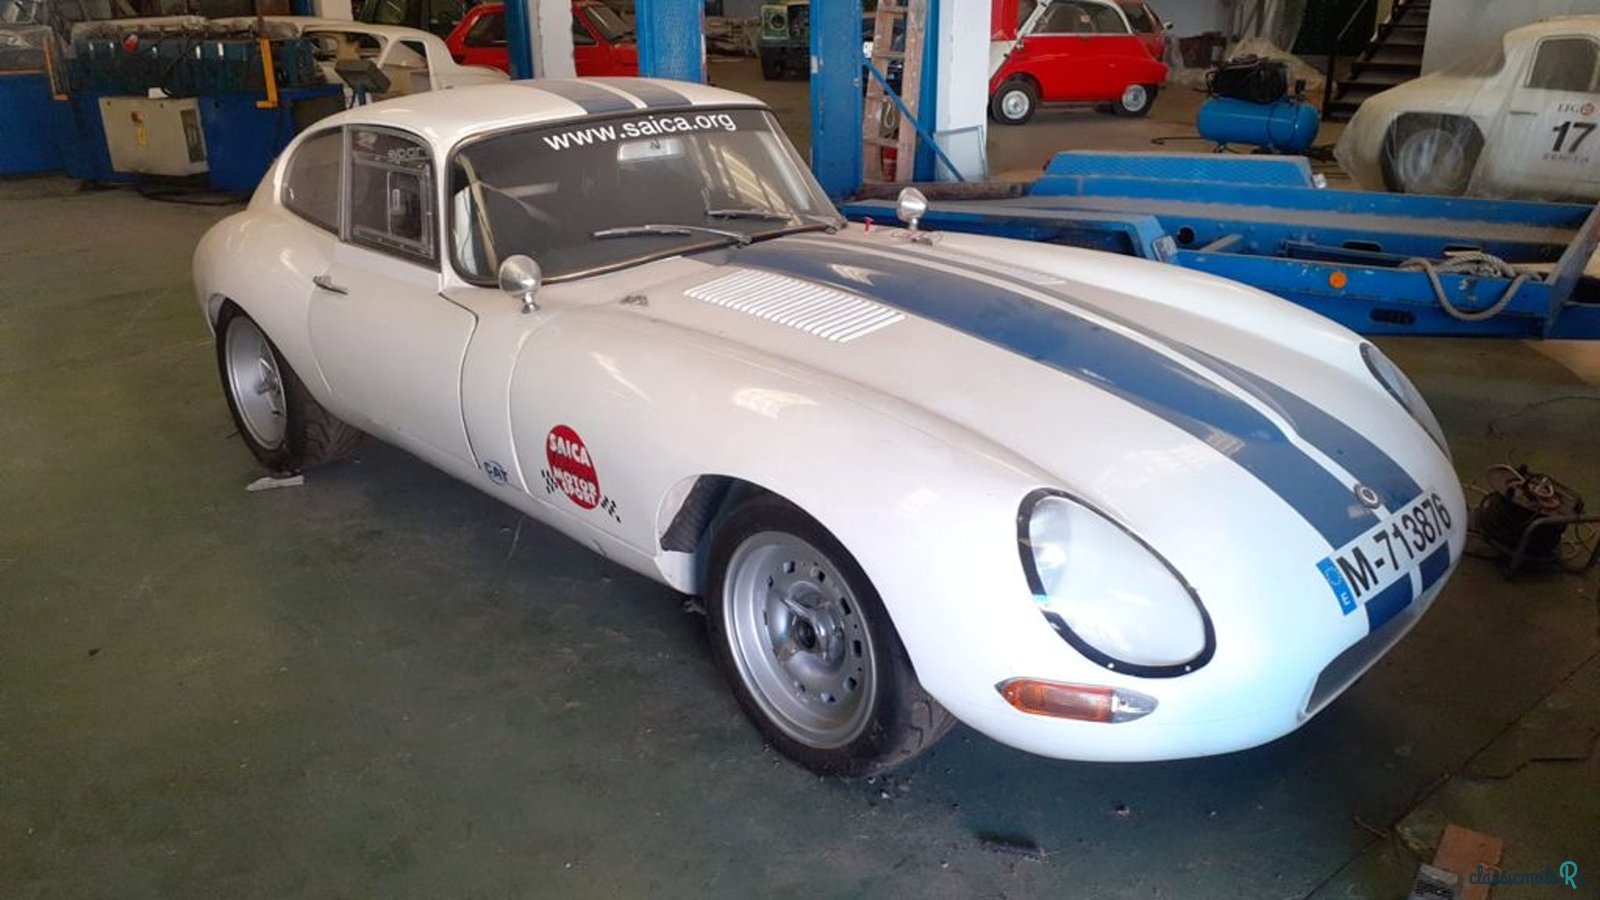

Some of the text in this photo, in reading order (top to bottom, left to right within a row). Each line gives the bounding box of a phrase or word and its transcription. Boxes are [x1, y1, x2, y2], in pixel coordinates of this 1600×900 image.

[543, 113, 737, 151] www.saica.org
[1552, 121, 1597, 153] 17
[549, 433, 592, 468] SAICA
[552, 465, 598, 498] MOTOR
[1336, 493, 1452, 598] M-713876
